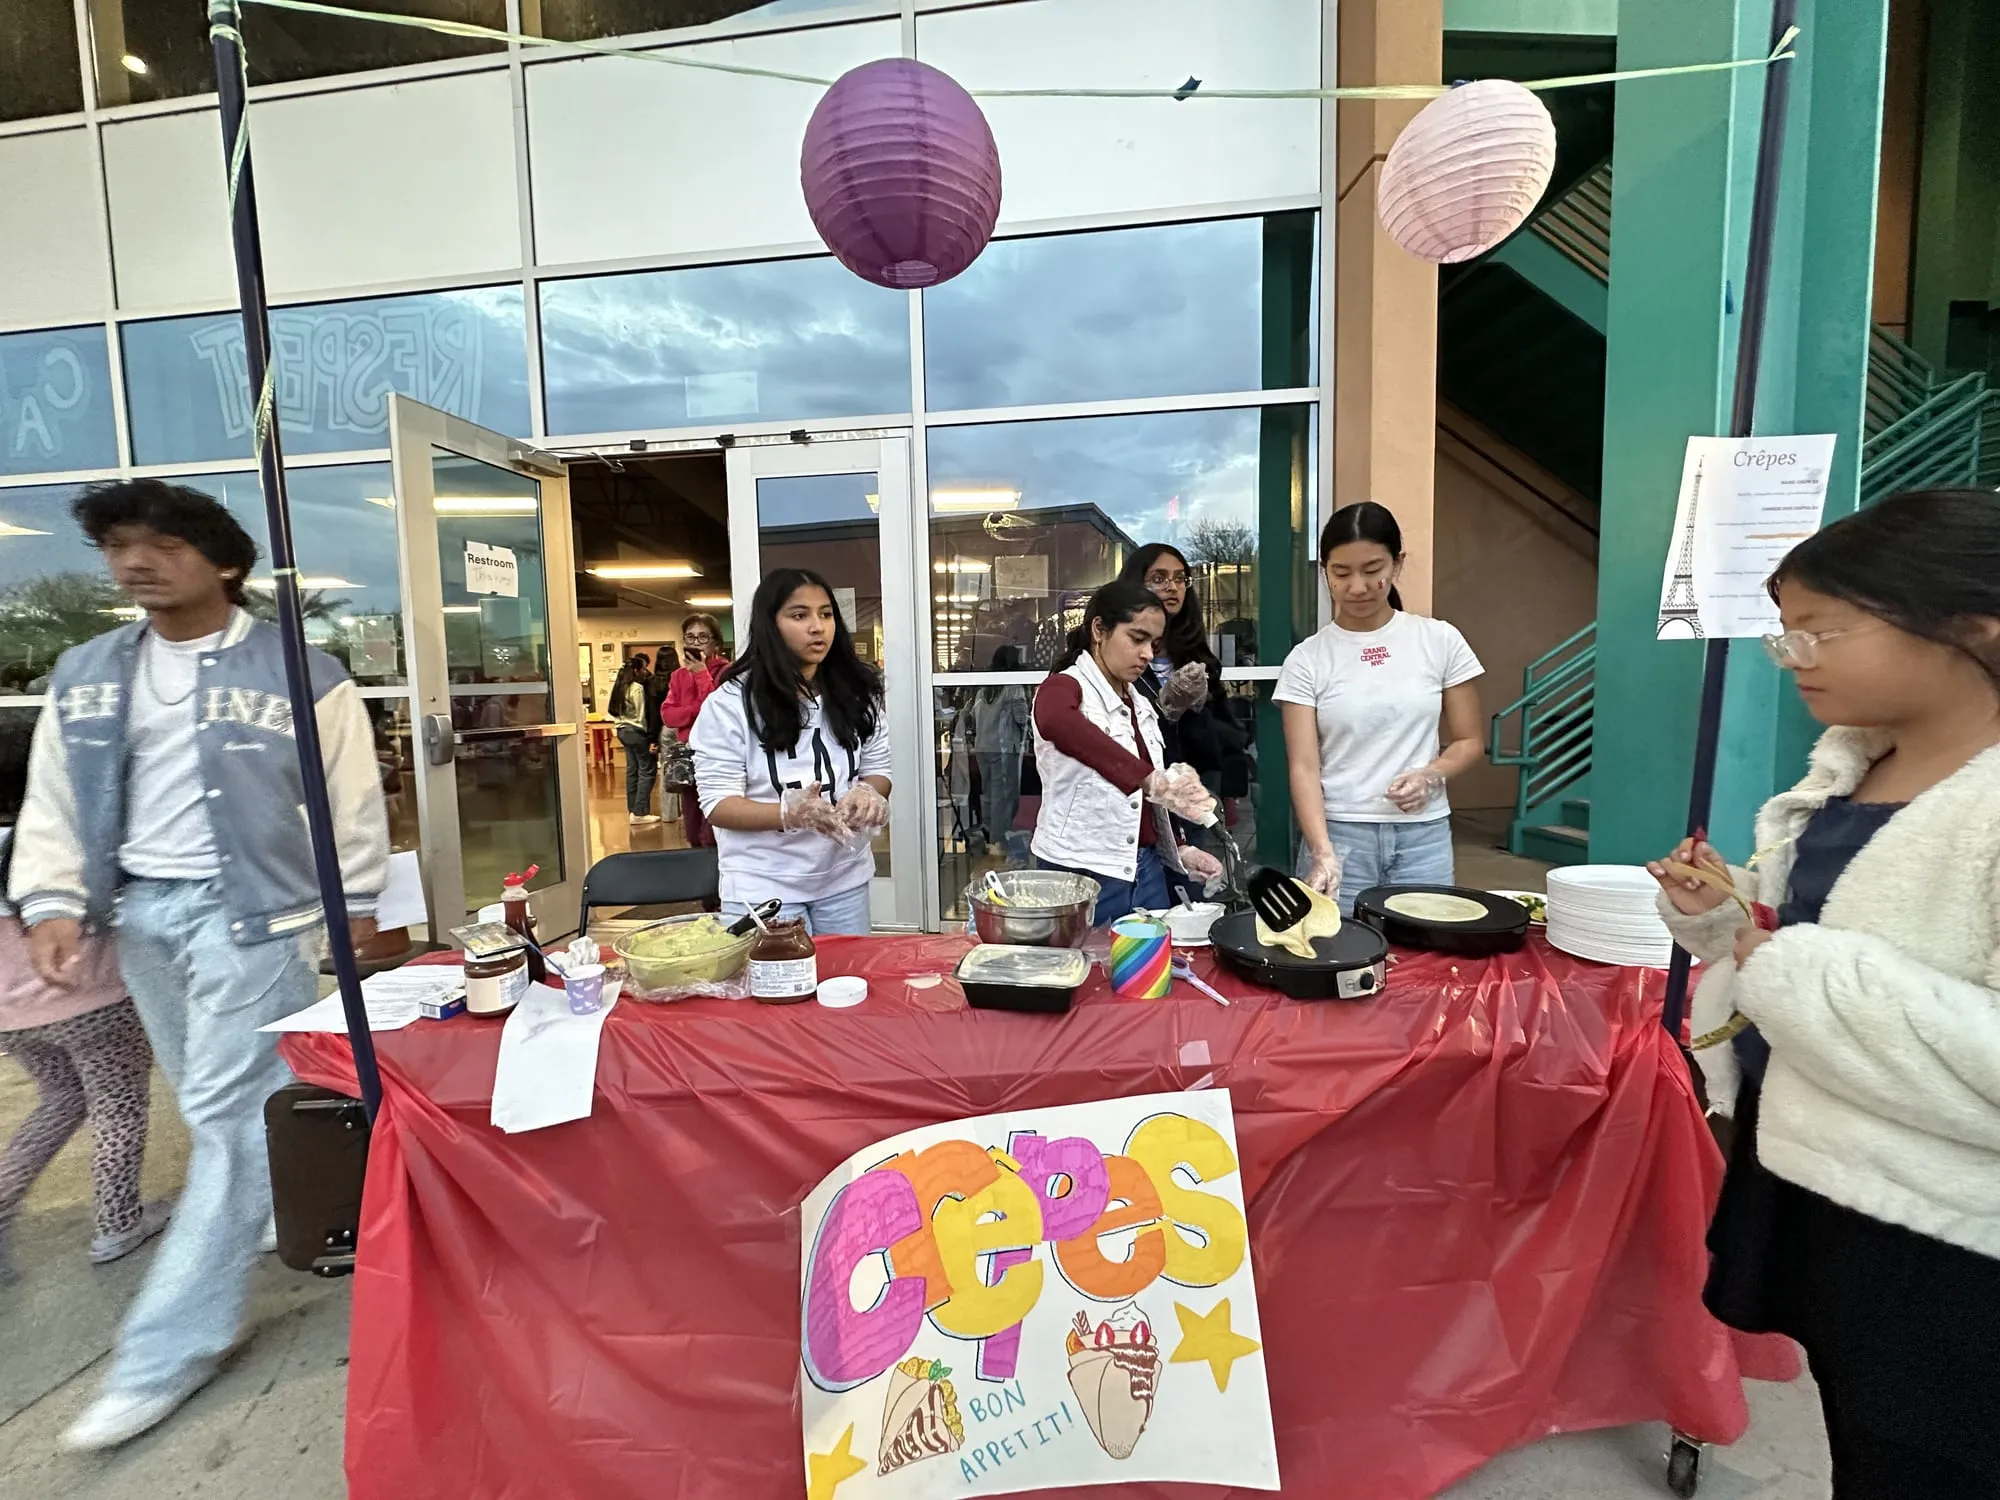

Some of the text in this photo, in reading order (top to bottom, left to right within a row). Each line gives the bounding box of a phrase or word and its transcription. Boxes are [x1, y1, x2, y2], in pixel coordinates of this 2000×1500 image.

[1733, 449, 1797, 471] Crêpes
[467, 552, 515, 569] Restroom
[1360, 652, 1391, 662] CENTRAL
[1362, 646, 1387, 655] GRAND
[1370, 659, 1385, 667] NYC
[969, 1379, 1026, 1422] BON
[960, 1401, 1075, 1484] APPETIT!
